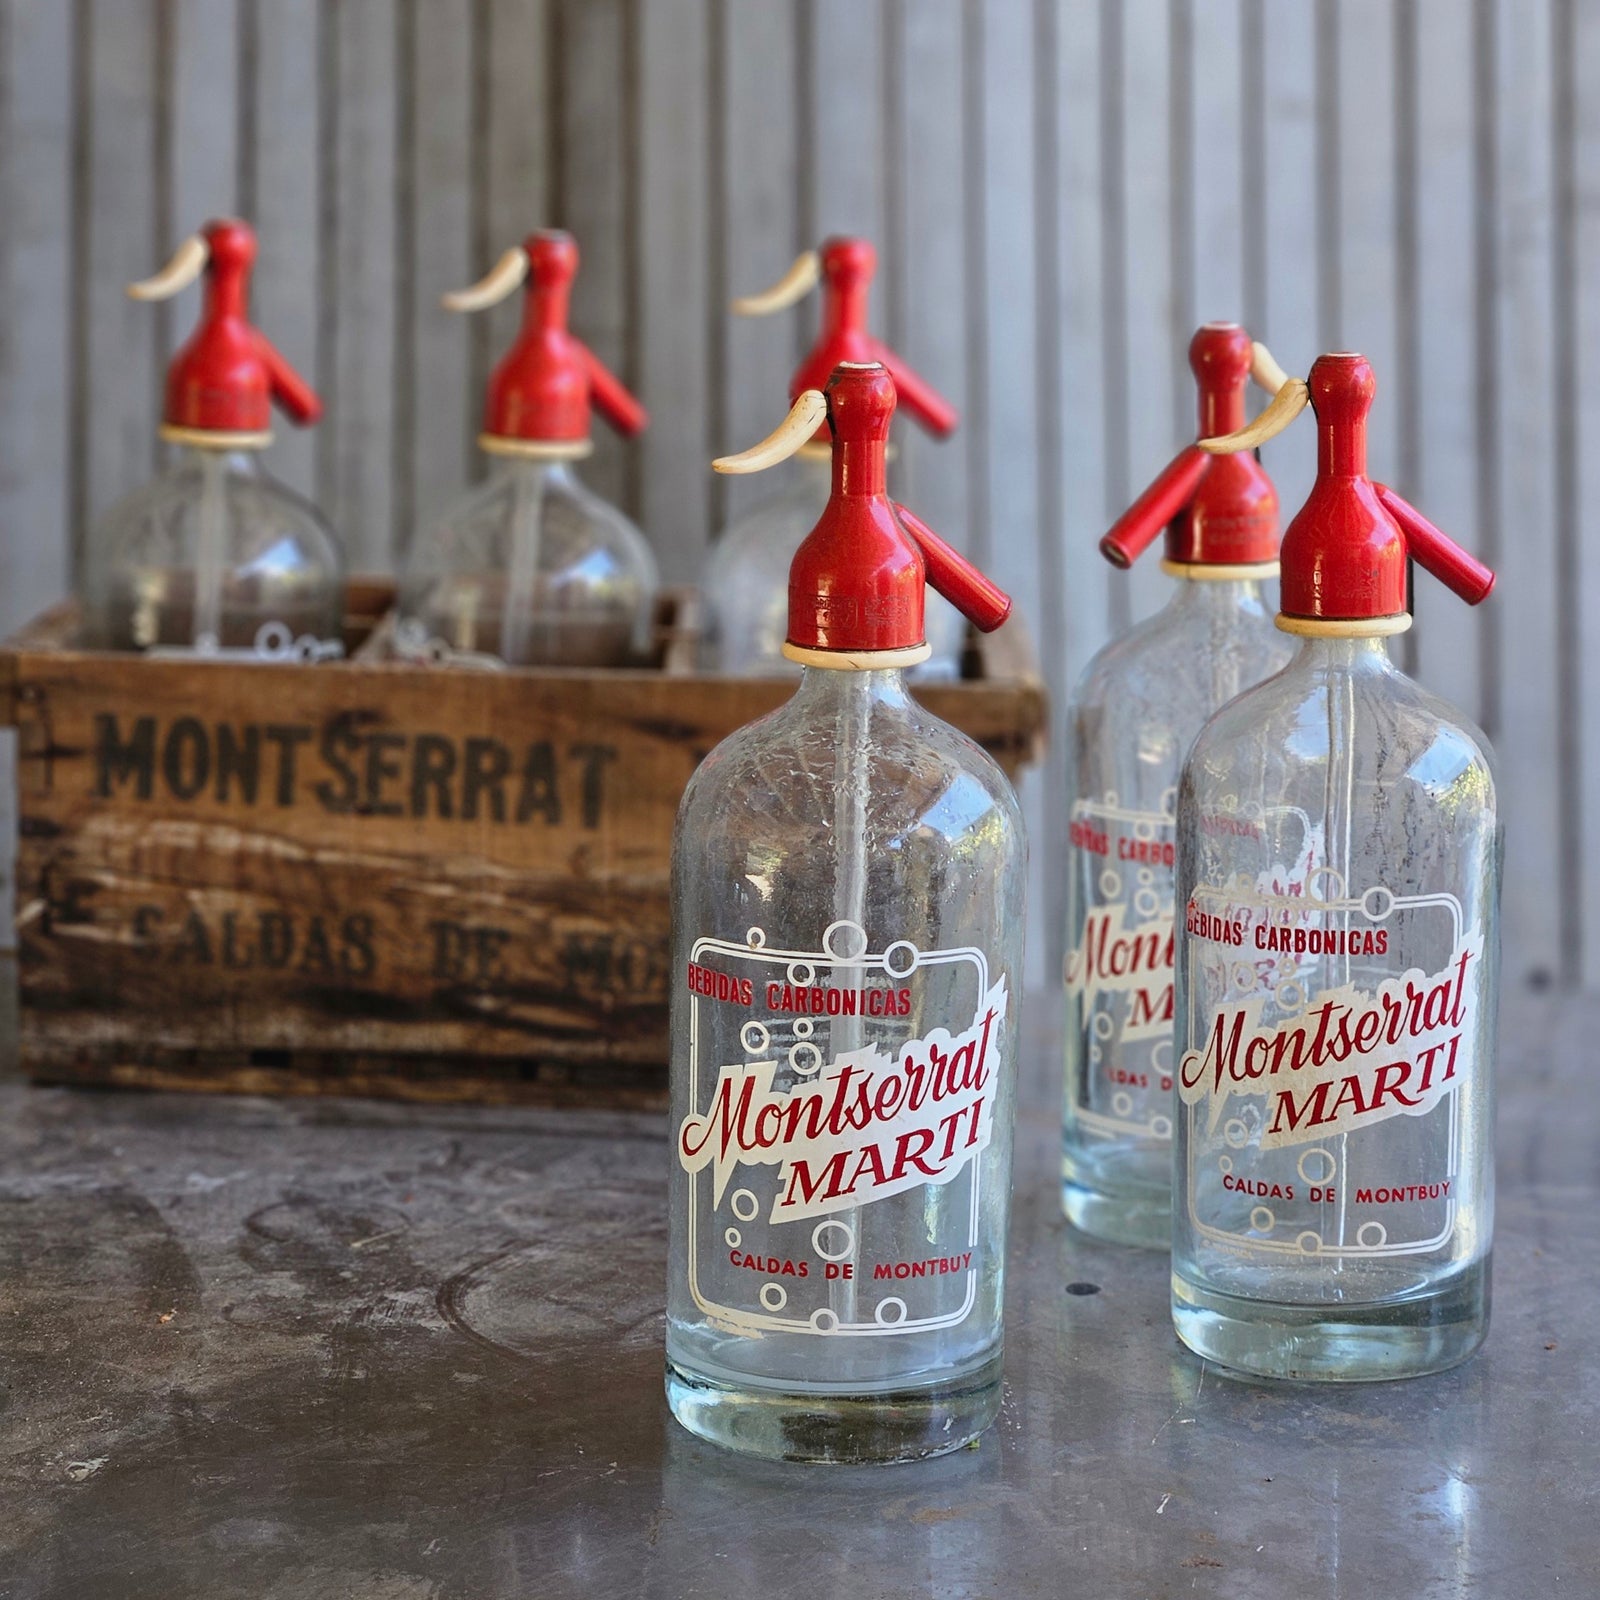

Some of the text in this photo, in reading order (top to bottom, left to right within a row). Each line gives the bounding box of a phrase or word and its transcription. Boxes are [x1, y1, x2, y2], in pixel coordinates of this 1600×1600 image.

[91, 709, 618, 830] MONTSERRAT
[687, 962, 912, 1017] BEBIDAS CARBONICAS
[1255, 924, 1388, 956] CARBONICAS
[1181, 948, 1475, 1095] Montserrat
[681, 1006, 999, 1165] Montserrat
[1268, 1032, 1463, 1134] MARTI
[780, 1096, 985, 1207] MARTI
[1222, 1174, 1451, 1204] CALDAS DE MONTBUY
[729, 1249, 972, 1280] CALDAS DE MONTBUY
